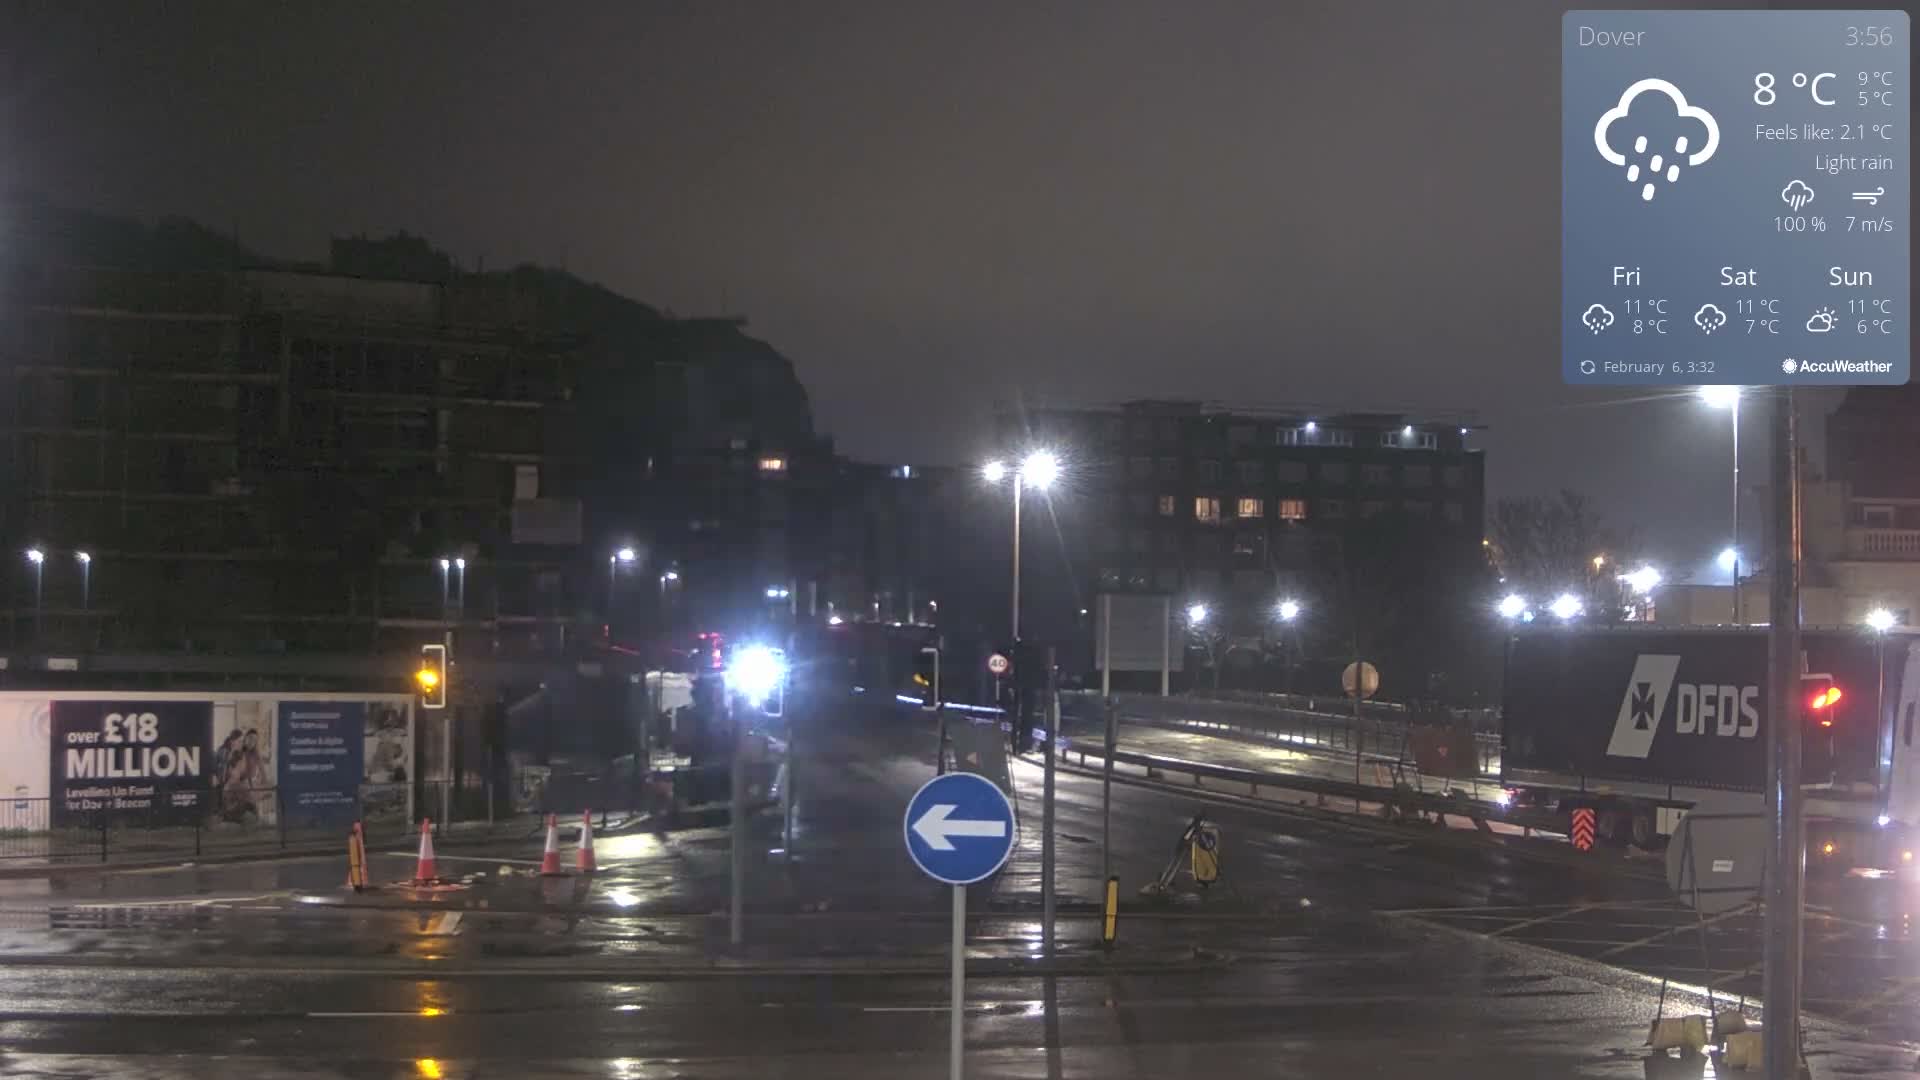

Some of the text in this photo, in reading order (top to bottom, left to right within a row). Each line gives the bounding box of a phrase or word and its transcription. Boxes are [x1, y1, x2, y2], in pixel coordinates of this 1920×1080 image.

[991, 659, 1006, 667] 40
[1676, 683, 1759, 738] DFDS
[67, 712, 159, 744] over £18
[66, 746, 200, 779] MILLION
